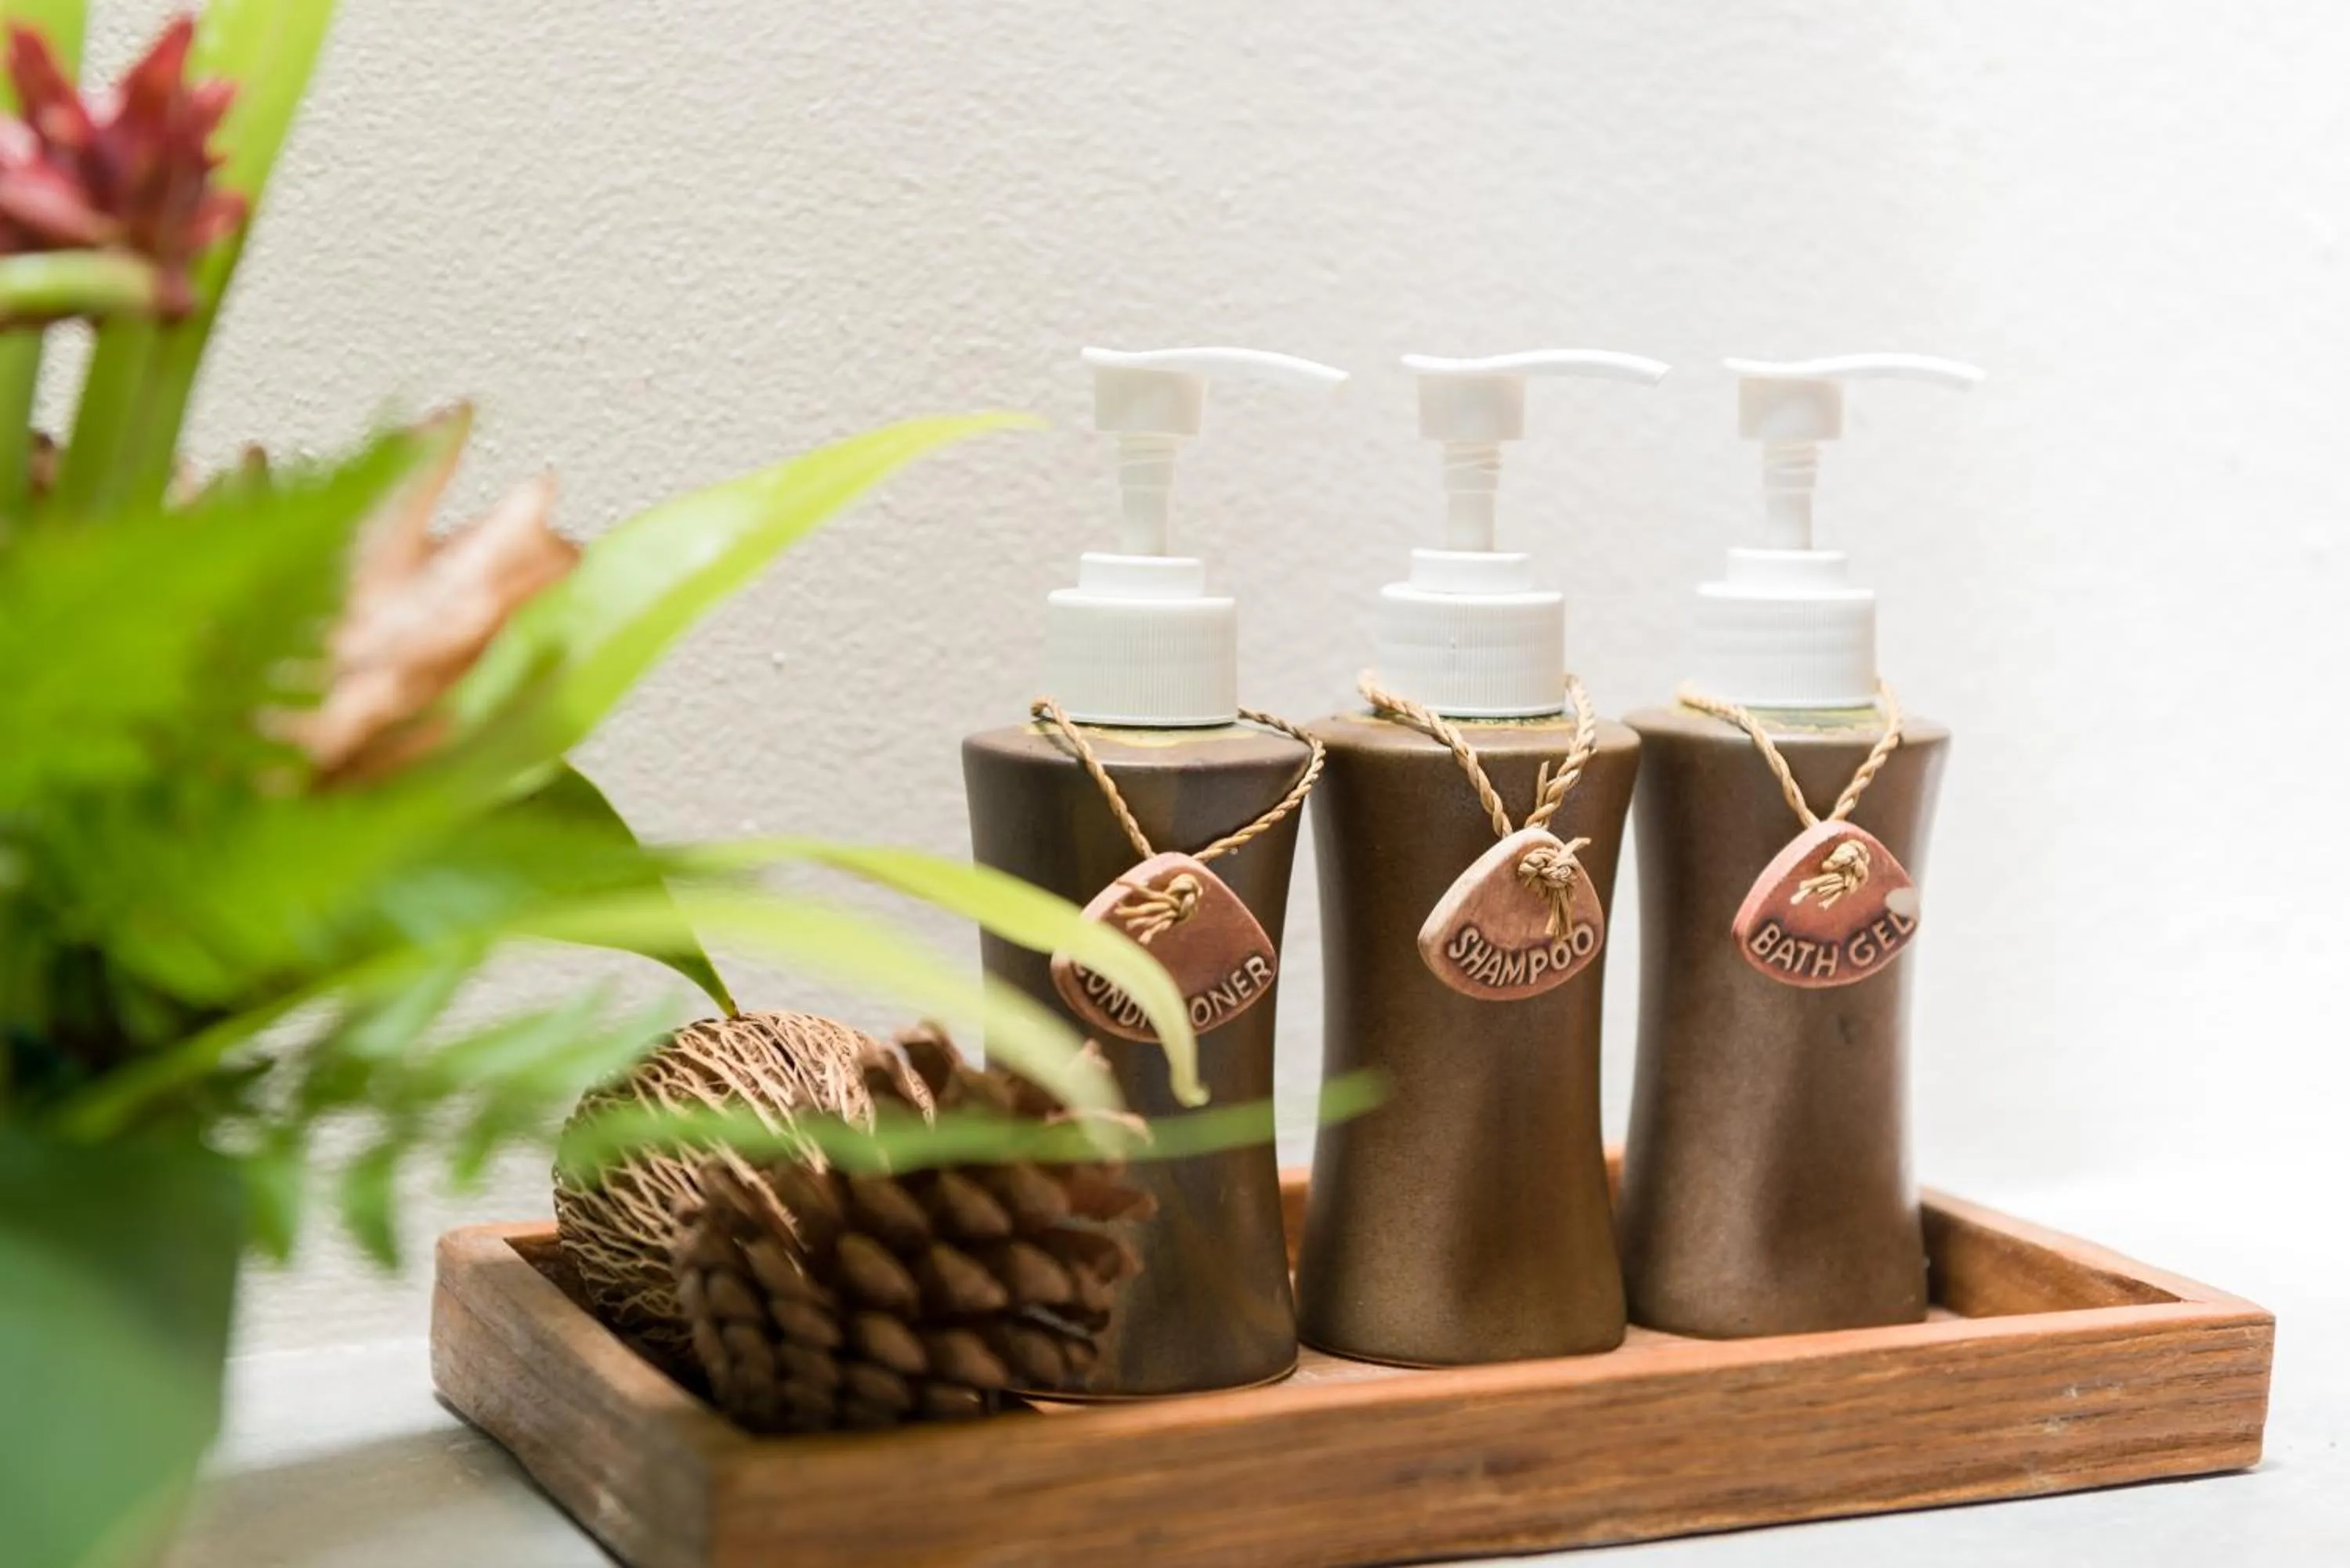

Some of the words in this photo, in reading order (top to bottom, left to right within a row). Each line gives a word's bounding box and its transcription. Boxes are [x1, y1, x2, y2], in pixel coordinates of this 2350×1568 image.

[1449, 923, 1594, 987] SHAMPOO
[1751, 923, 1839, 977] BATH
[1849, 912, 1914, 966] GEL
[1071, 956, 1271, 1028] ONDONER
